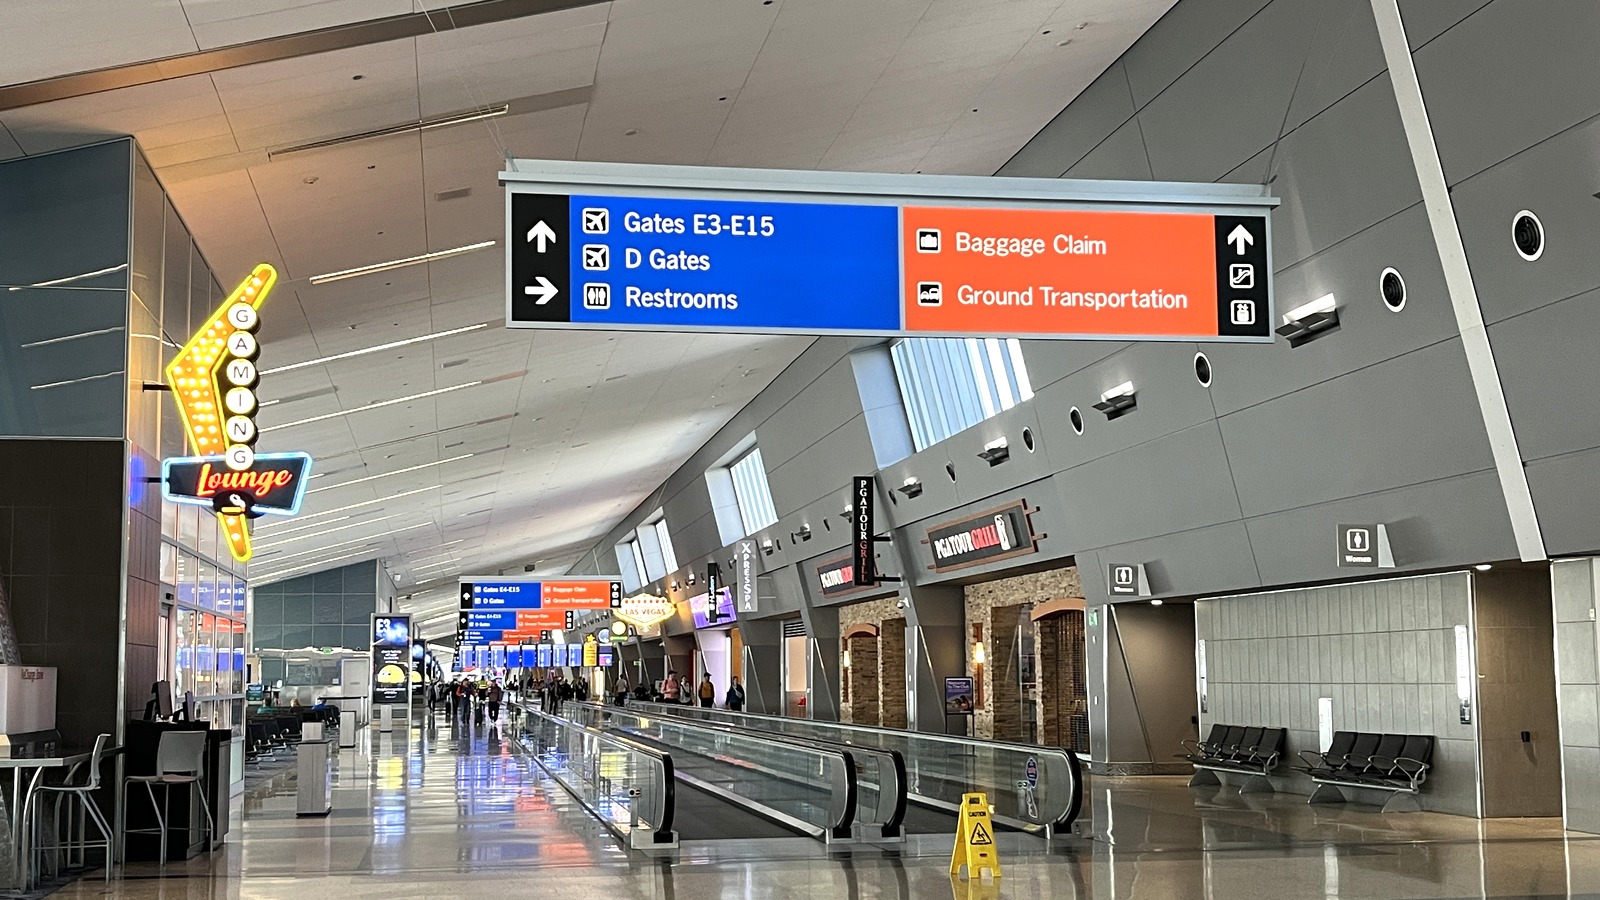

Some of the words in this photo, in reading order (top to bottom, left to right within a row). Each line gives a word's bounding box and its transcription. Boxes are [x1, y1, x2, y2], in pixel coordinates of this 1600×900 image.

[624, 211, 685, 235] Gates
[693, 213, 775, 237] E3-E15
[955, 231, 1046, 257] Baggage
[1053, 233, 1107, 255] Claim
[625, 247, 642, 269] D
[649, 248, 710, 272] Gates
[625, 286, 738, 310] Restrooms
[957, 285, 1033, 307] Ground
[1039, 286, 1188, 311] Transportation
[197, 463, 292, 497] Lounge
[1345, 555, 1372, 563] Women
[641, 608, 666, 616] VEGAS
[376, 618, 391, 633] E3
